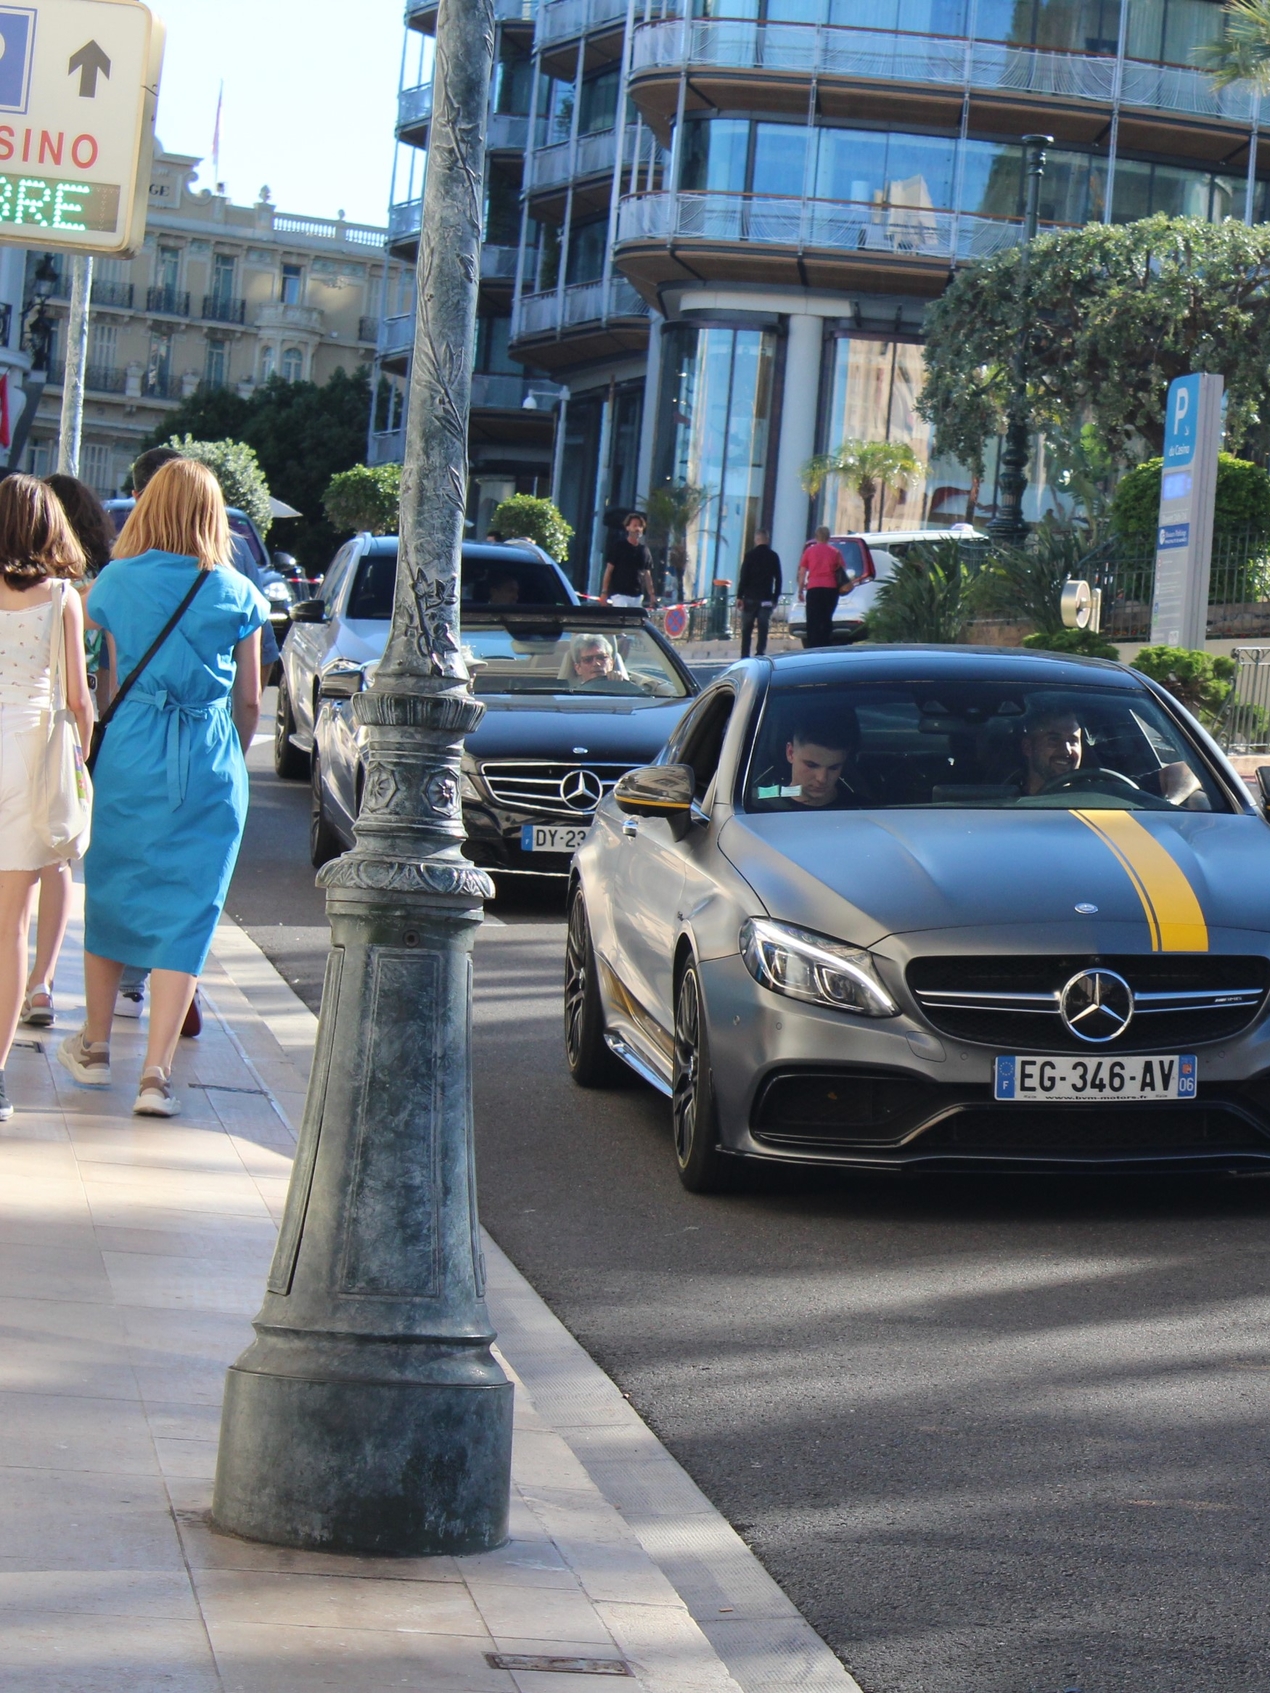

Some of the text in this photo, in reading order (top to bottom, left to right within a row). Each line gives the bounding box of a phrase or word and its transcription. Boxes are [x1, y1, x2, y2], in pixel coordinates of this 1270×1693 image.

[1175, 444, 1190, 456] Casino
[1002, 1059, 1194, 1092] F EG-346-AV 06
